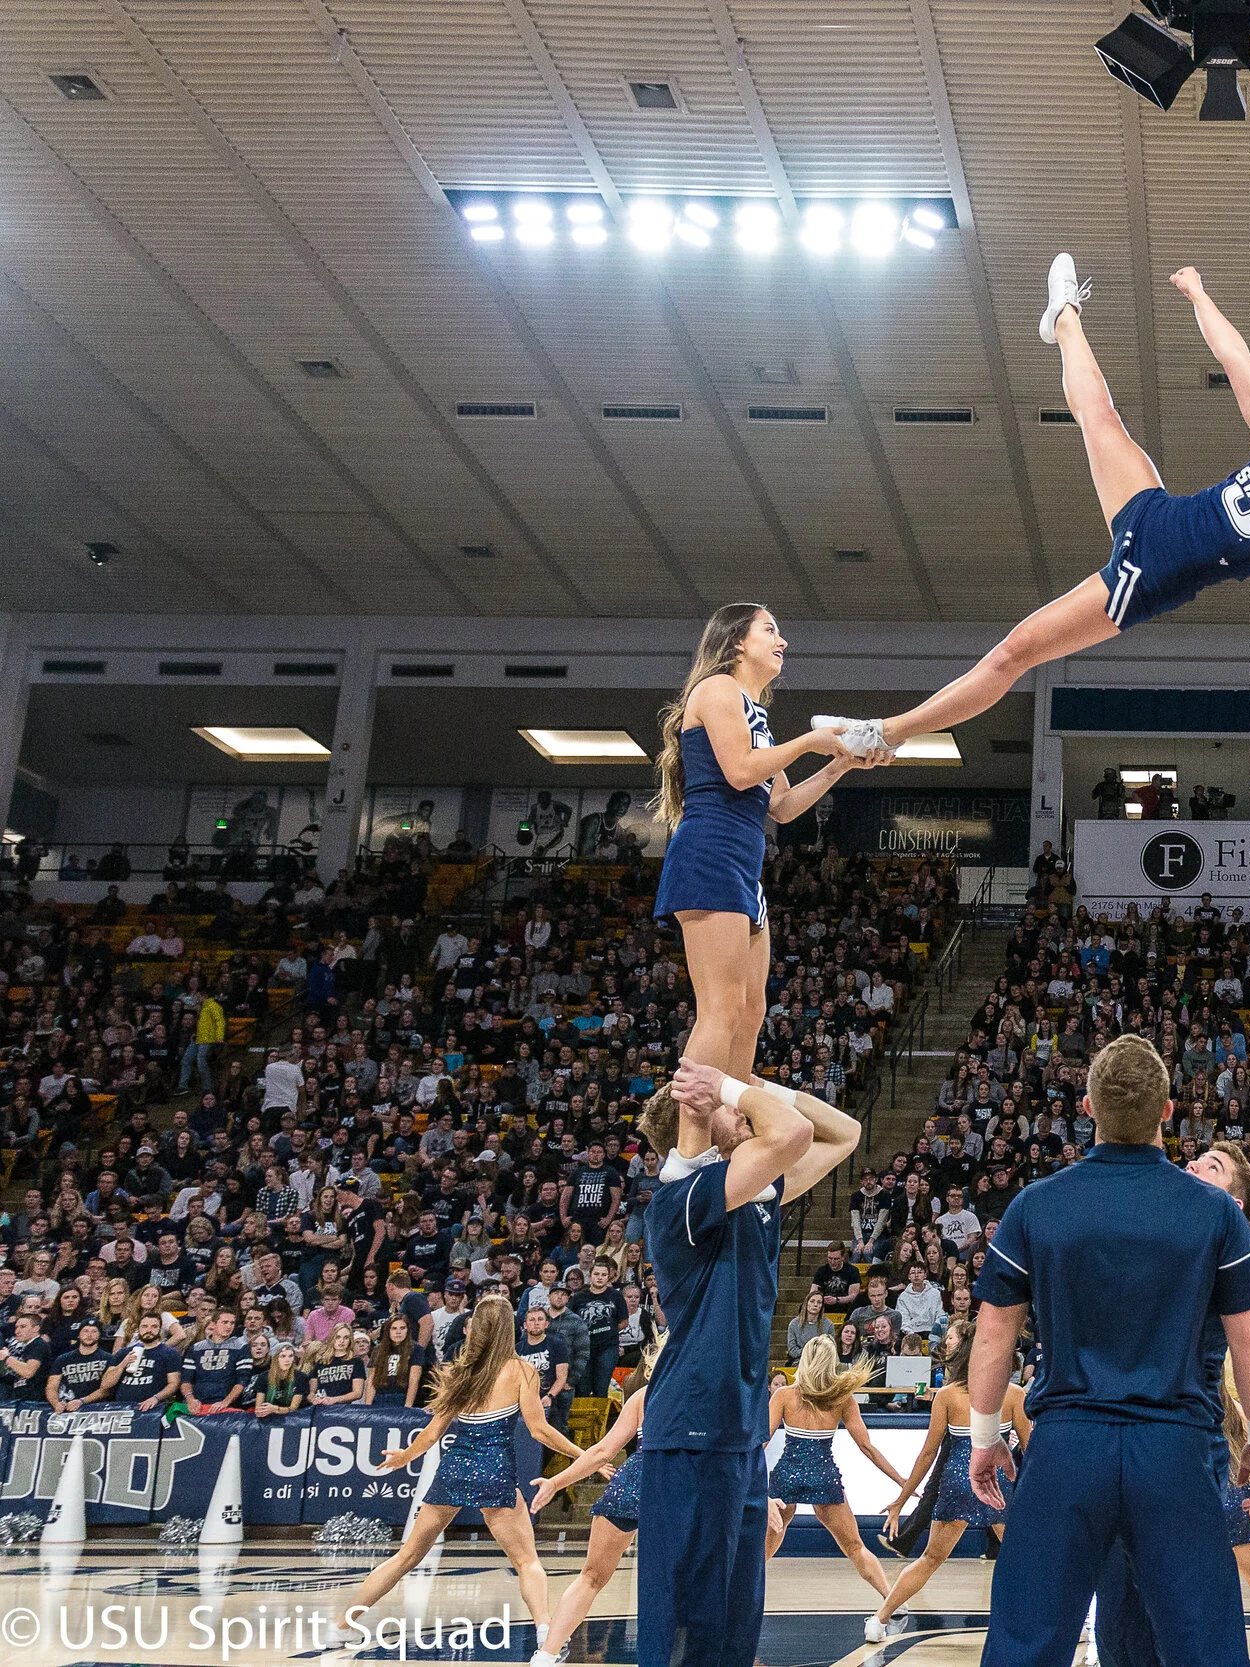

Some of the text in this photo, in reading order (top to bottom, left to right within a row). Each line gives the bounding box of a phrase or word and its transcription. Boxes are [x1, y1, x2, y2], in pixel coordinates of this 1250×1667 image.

[332, 789, 344, 804] J
[1041, 795, 1052, 810] L
[972, 799, 1032, 822] STA
[879, 830, 963, 851] CONSERVICE
[1159, 844, 1186, 877] F
[1209, 870, 1247, 882] Home
[1091, 901, 1115, 910] 2175
[1116, 901, 1141, 910] Noh
[579, 1184, 605, 1193] TRUE
[578, 1193, 603, 1204] BLUE
[62, 1360, 107, 1377] AGGIES
[317, 1364, 354, 1377] AGGIES
[122, 1376, 153, 1386] STATE
[328, 1373, 352, 1382] WAY
[47, 1409, 134, 1434] STATE
[267, 1426, 402, 1477] USU
